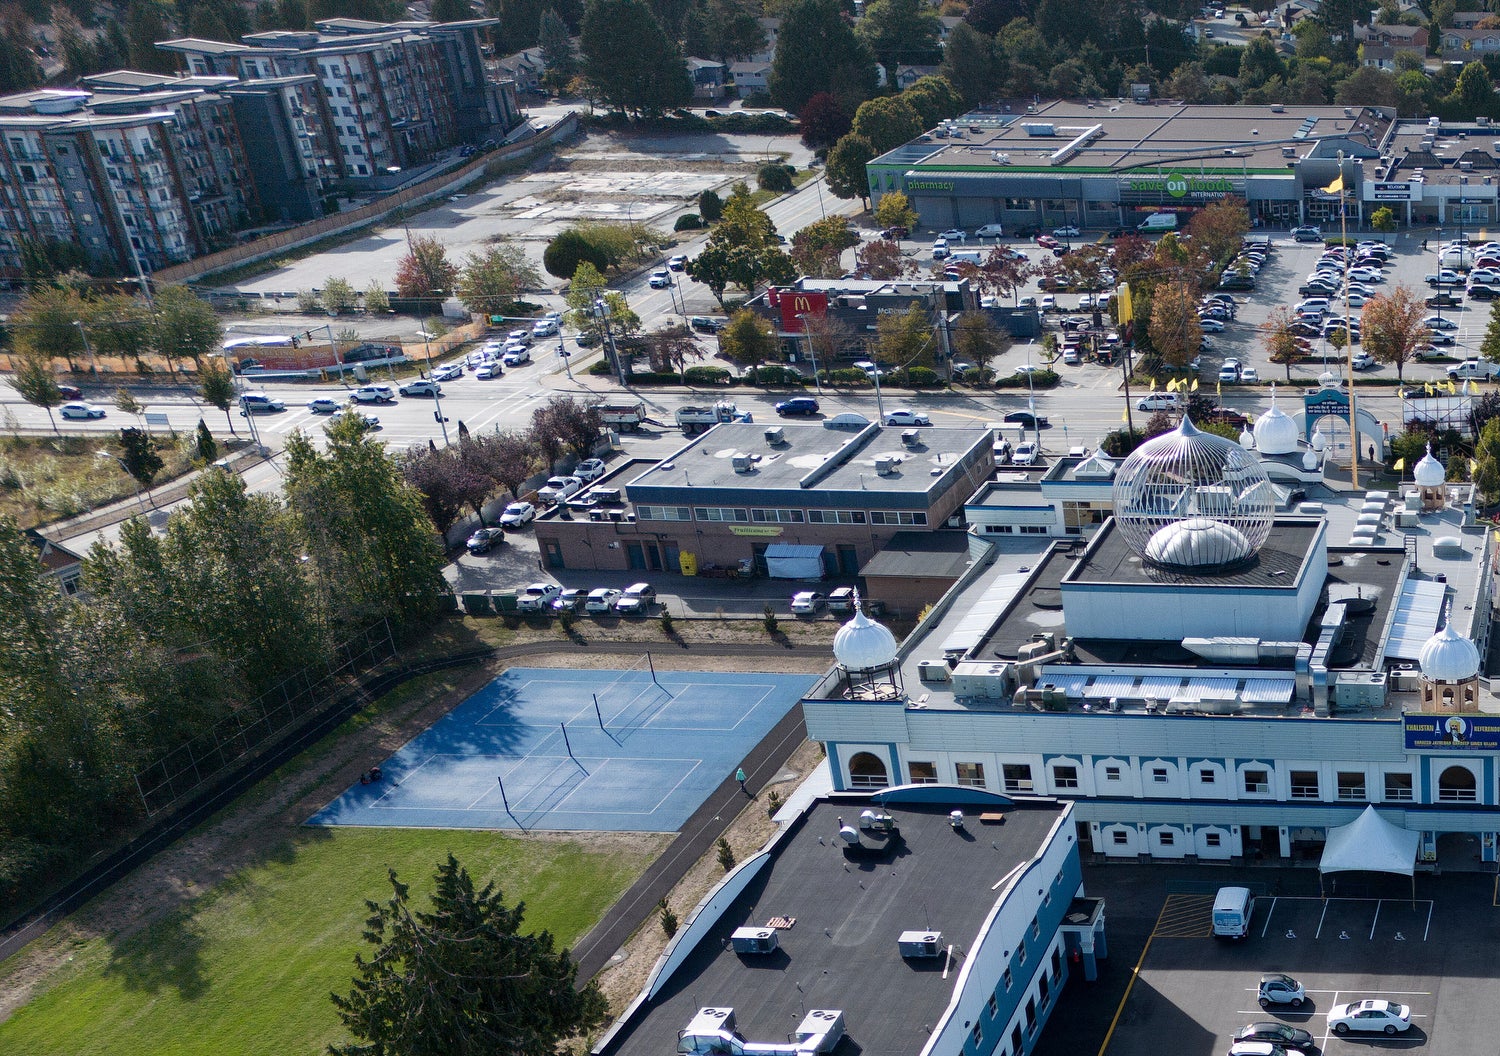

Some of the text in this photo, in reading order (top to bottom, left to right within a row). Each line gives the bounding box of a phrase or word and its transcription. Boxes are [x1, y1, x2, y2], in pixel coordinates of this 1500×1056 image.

[908, 180, 954, 191] pharmacy
[1130, 178, 1233, 191] save on foods
